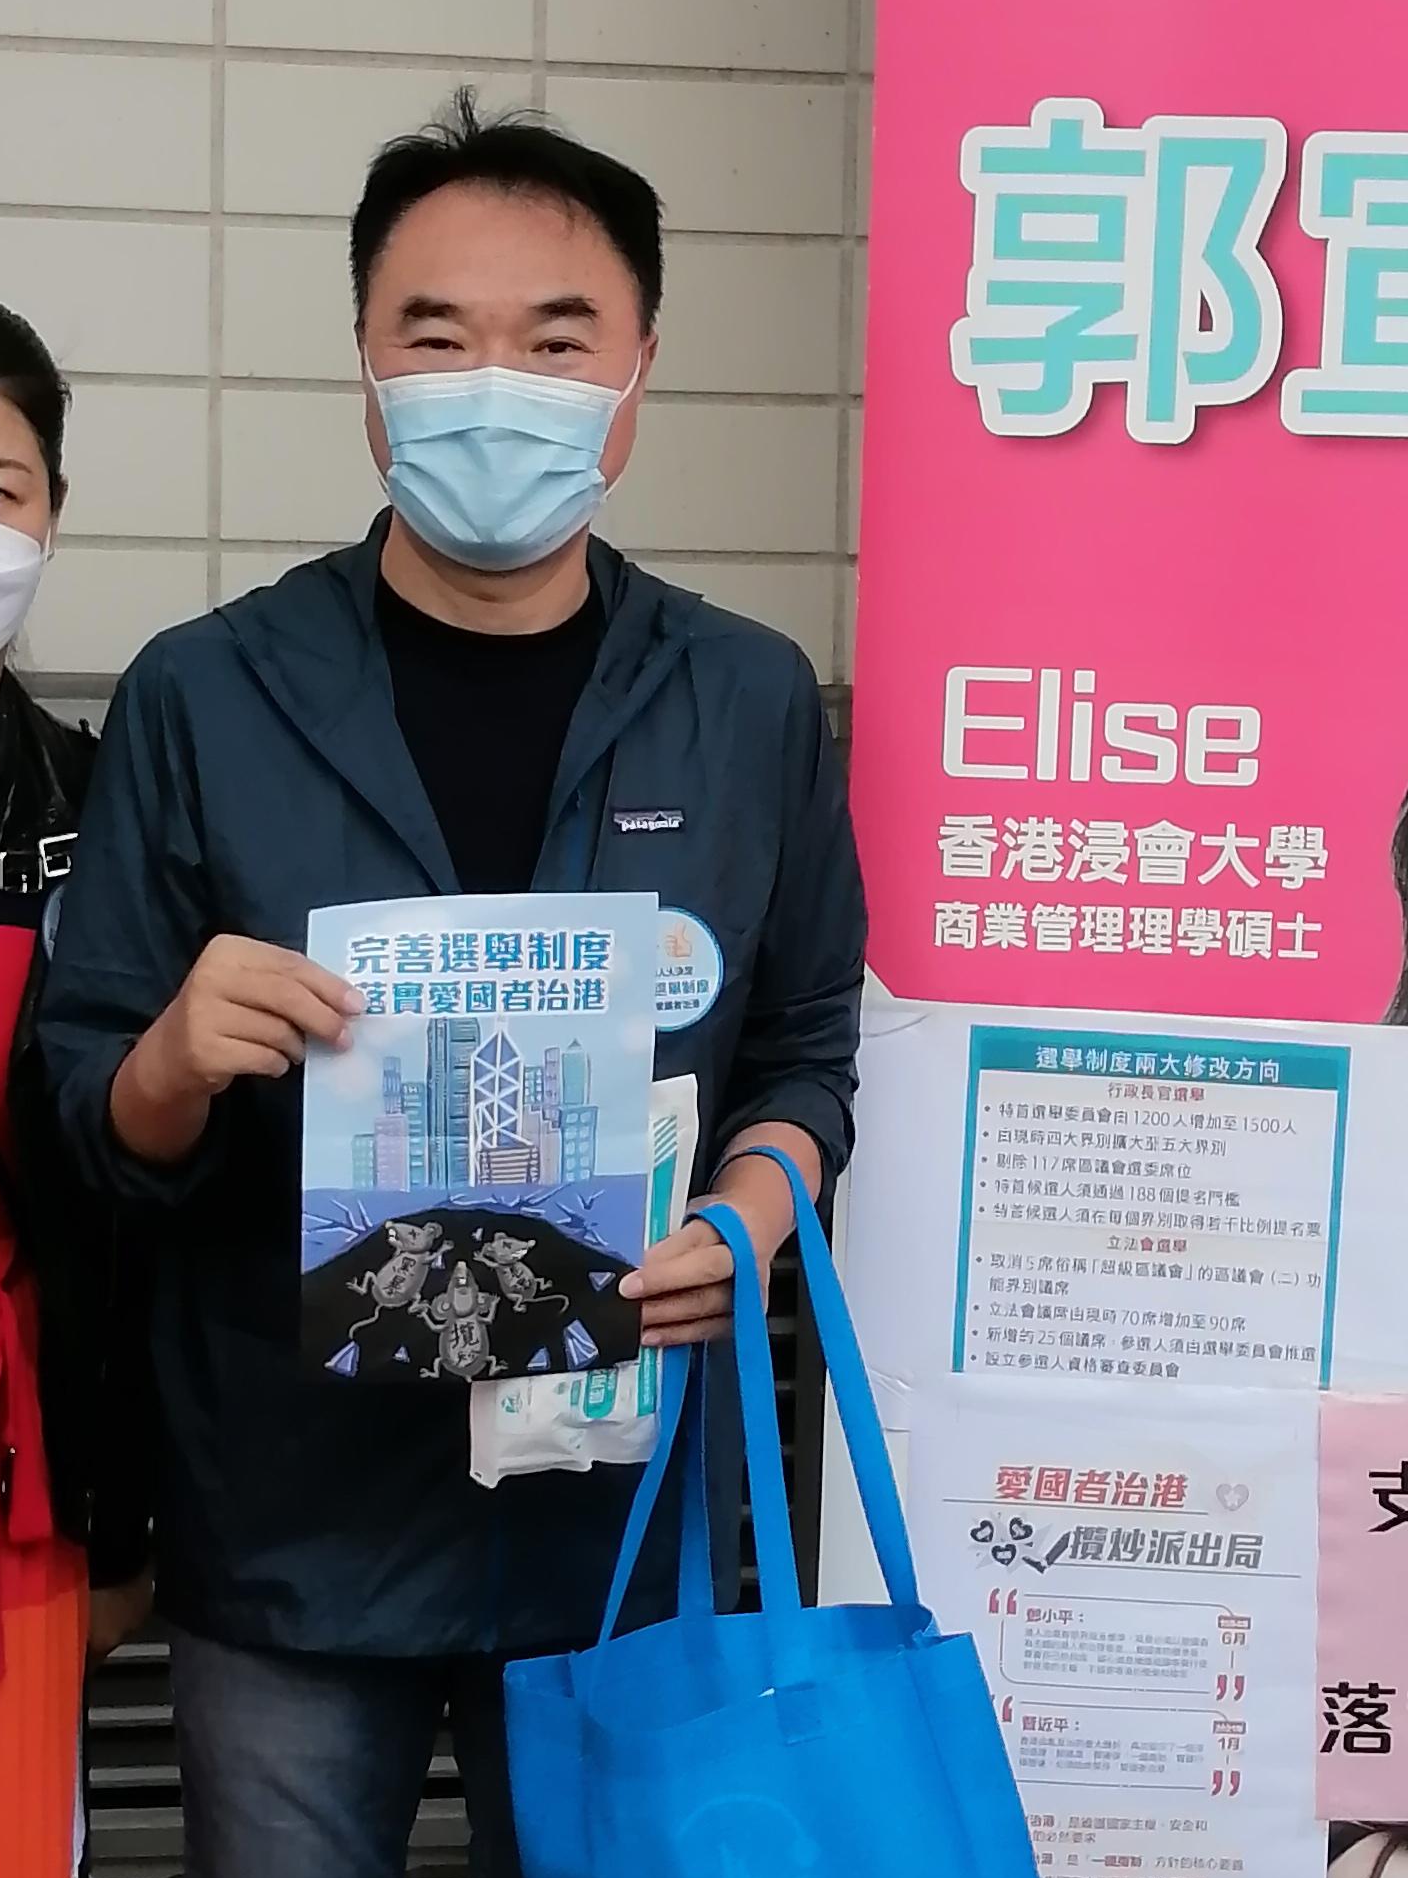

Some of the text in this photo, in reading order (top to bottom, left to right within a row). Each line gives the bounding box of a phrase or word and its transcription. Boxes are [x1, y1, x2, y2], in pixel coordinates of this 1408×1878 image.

[942, 666, 1261, 786] Elise
[937, 815, 1328, 889] 香港浸會大學
[933, 901, 1322, 959] 商業管理理學碩士
[349, 931, 612, 974] 完善選舉制度
[355, 981, 606, 1013] 落實愛國者治港
[1035, 1045, 1280, 1084] 選舉制度兩大修改方向
[1107, 1083, 1205, 1102] 行政長官選舉
[1106, 1235, 1188, 1253] 立法會選舉
[994, 1466, 1189, 1508] 愛國者治港
